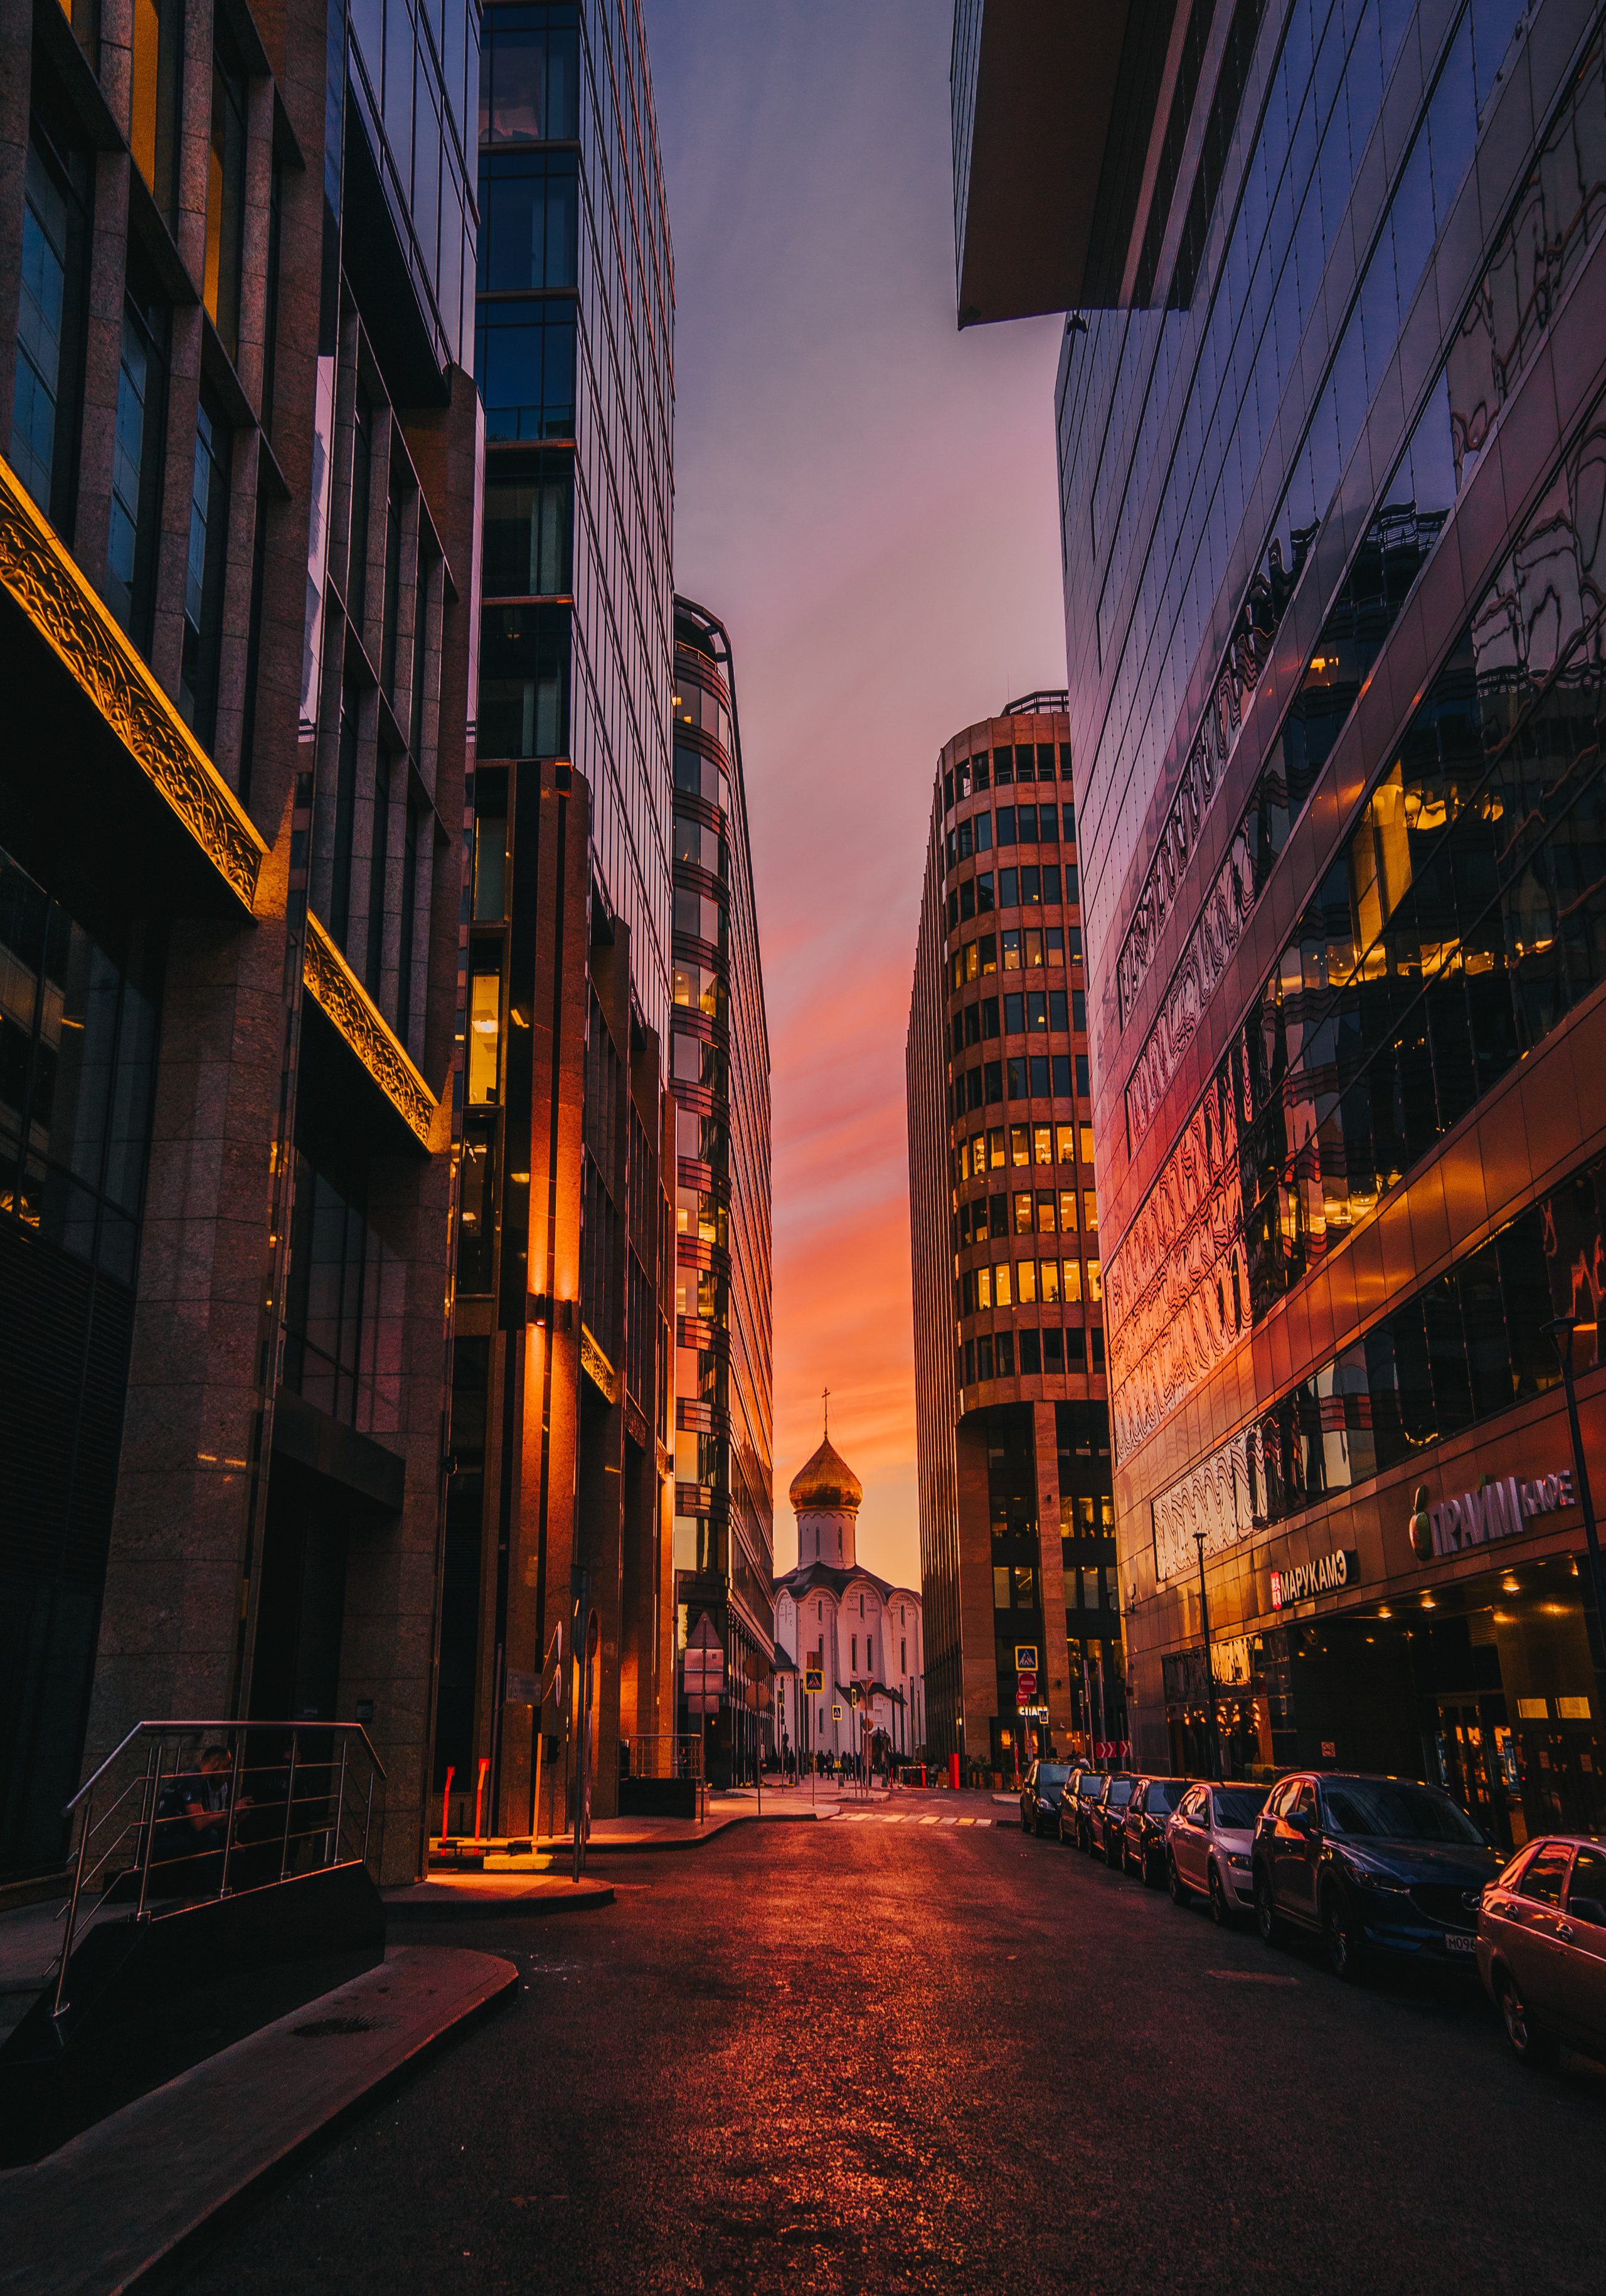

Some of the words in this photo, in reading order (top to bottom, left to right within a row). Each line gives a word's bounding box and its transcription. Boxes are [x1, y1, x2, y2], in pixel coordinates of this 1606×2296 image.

[1428, 1474, 1524, 1556] ПРАЙМ
[1521, 1470, 1576, 1517] КАФЕ
[1280, 1549, 1347, 1603] МАРУКАМЭ
